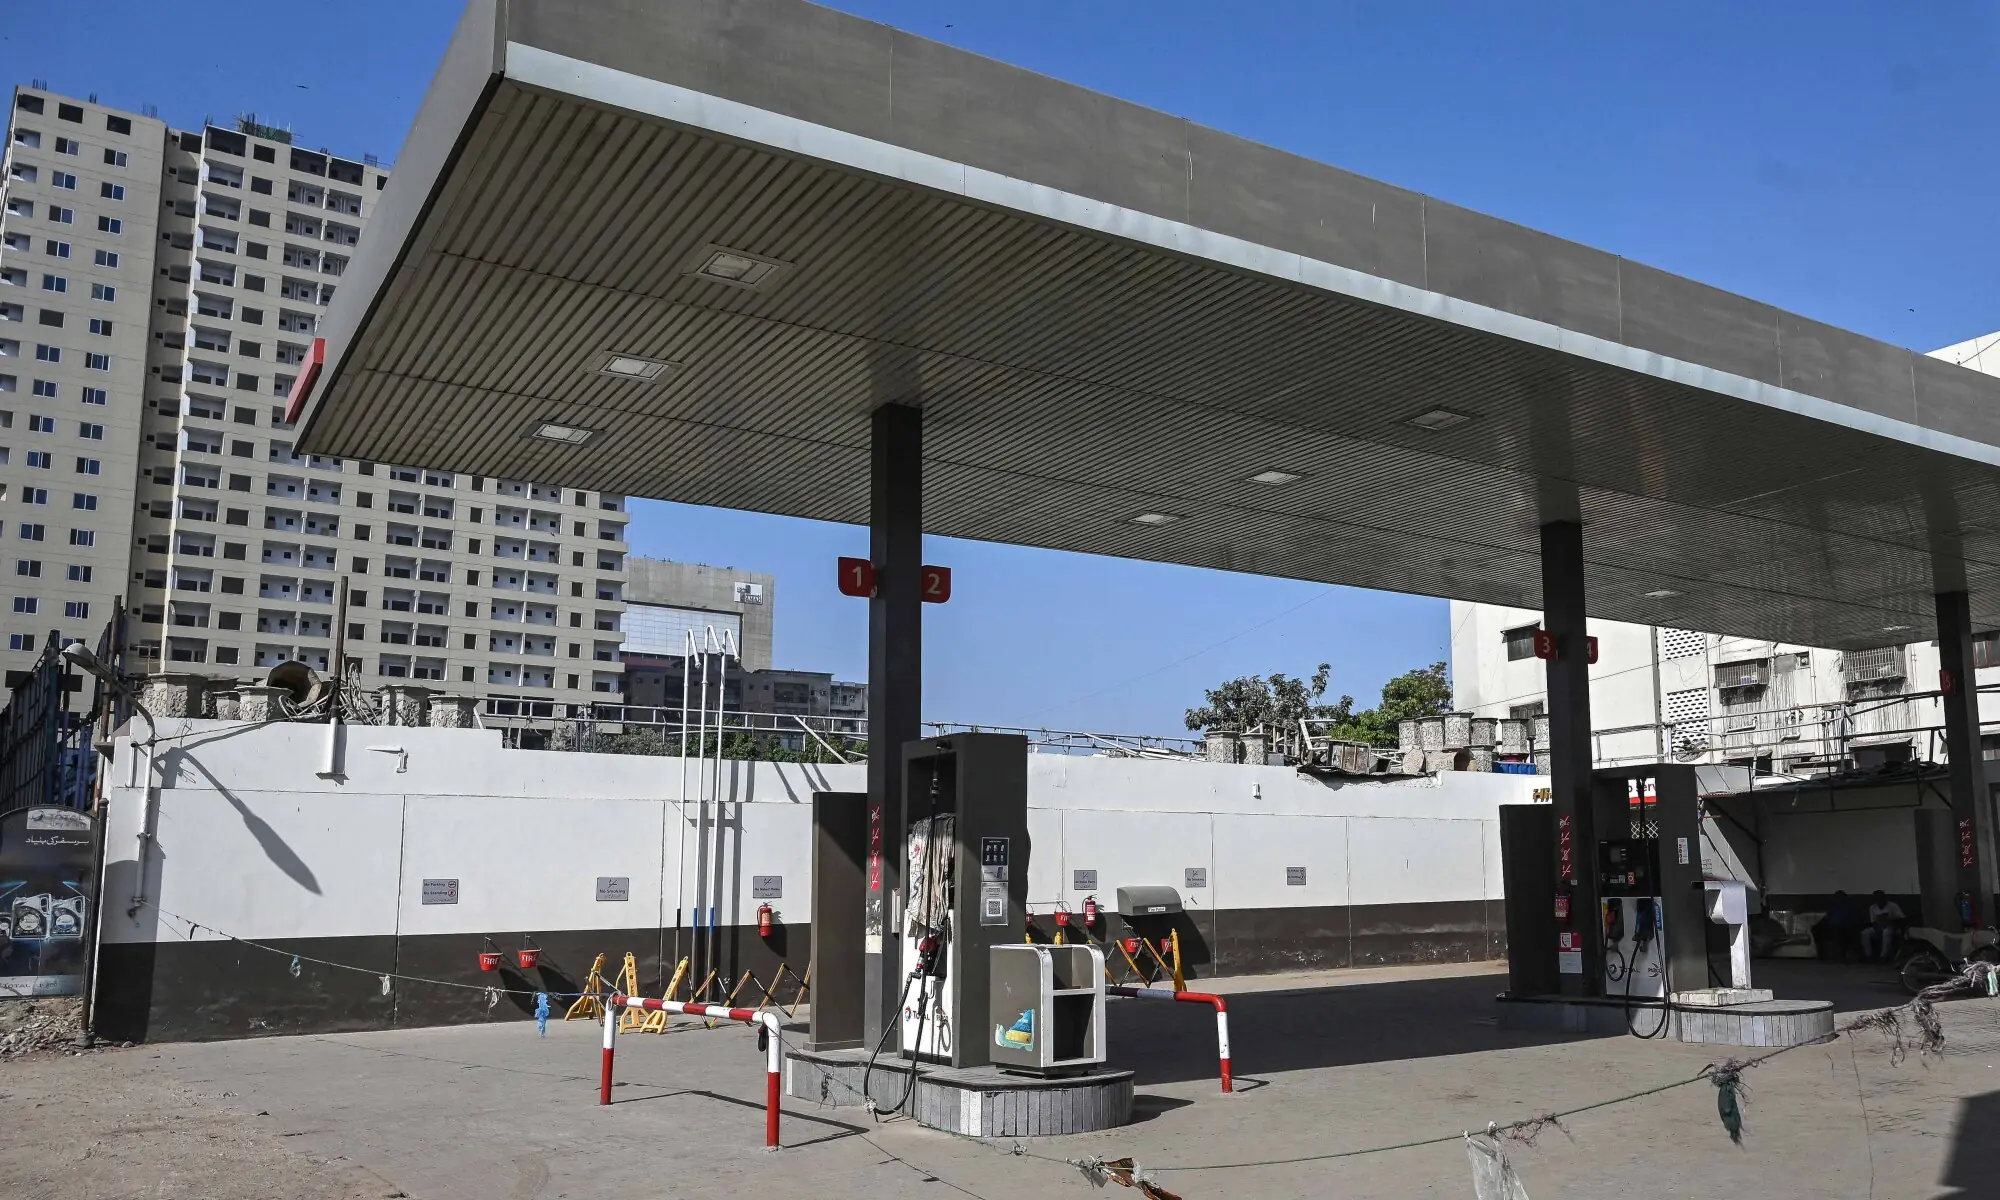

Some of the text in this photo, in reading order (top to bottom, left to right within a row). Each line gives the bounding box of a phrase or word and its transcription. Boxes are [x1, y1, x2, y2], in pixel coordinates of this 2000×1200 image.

[852, 565, 863, 588] 1
[926, 573, 942, 595] 2
[1542, 636, 1551, 654] 3
